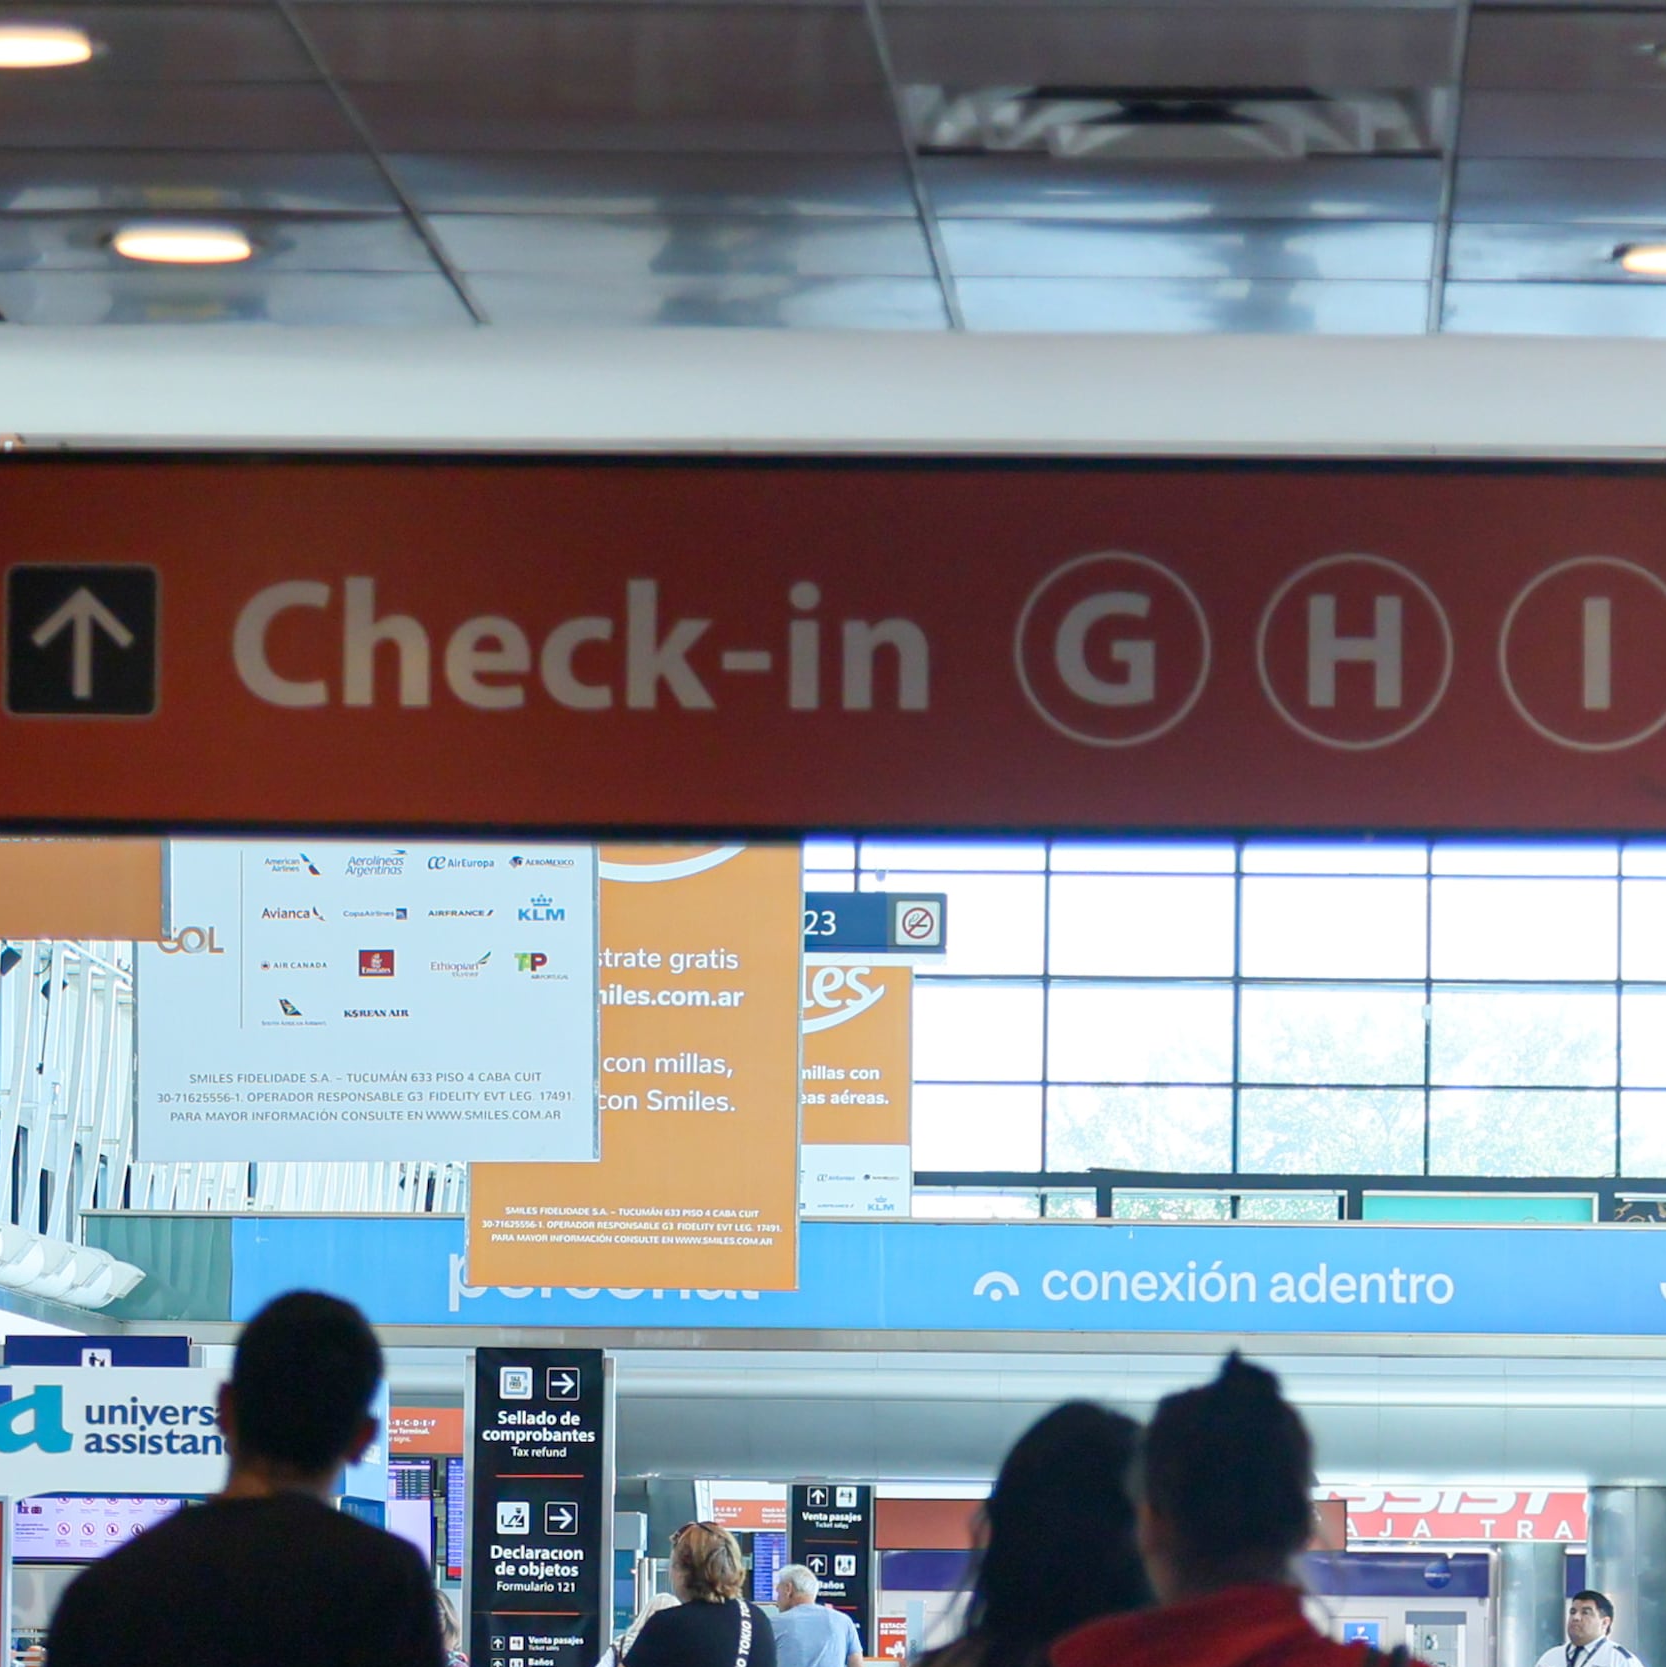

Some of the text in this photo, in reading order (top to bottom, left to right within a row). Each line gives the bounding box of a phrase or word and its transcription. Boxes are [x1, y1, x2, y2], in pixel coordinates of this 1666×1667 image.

[231, 578, 1609, 712] Check-in G H I
[345, 865, 404, 877] Argentinas
[262, 907, 310, 920] Avianca
[518, 908, 565, 921] KLM
[273, 961, 327, 969] AIR CANADA
[430, 960, 479, 974] Ethiopian
[670, 950, 738, 974] gratis
[604, 1053, 734, 1080] con millas,
[647, 1090, 736, 1111] Smiles.
[170, 1109, 561, 1121] PARA MAYOR INFORMACIÓN CONSULTE EN WWW.SMILES.COM.AR
[1043, 1260, 1454, 1304] conexión adentro
[85, 1396, 221, 1426] univers
[497, 1410, 581, 1426] Sellado de
[85, 1425, 227, 1455] assistan
[482, 1427, 595, 1444] comprobantes
[511, 1446, 567, 1457] Tax refund
[802, 1512, 862, 1523] Venta pasajes
[495, 1561, 579, 1580] de objetos
[496, 1581, 575, 1592] Formulario 121
[739, 1620, 752, 1655] TOKIO
